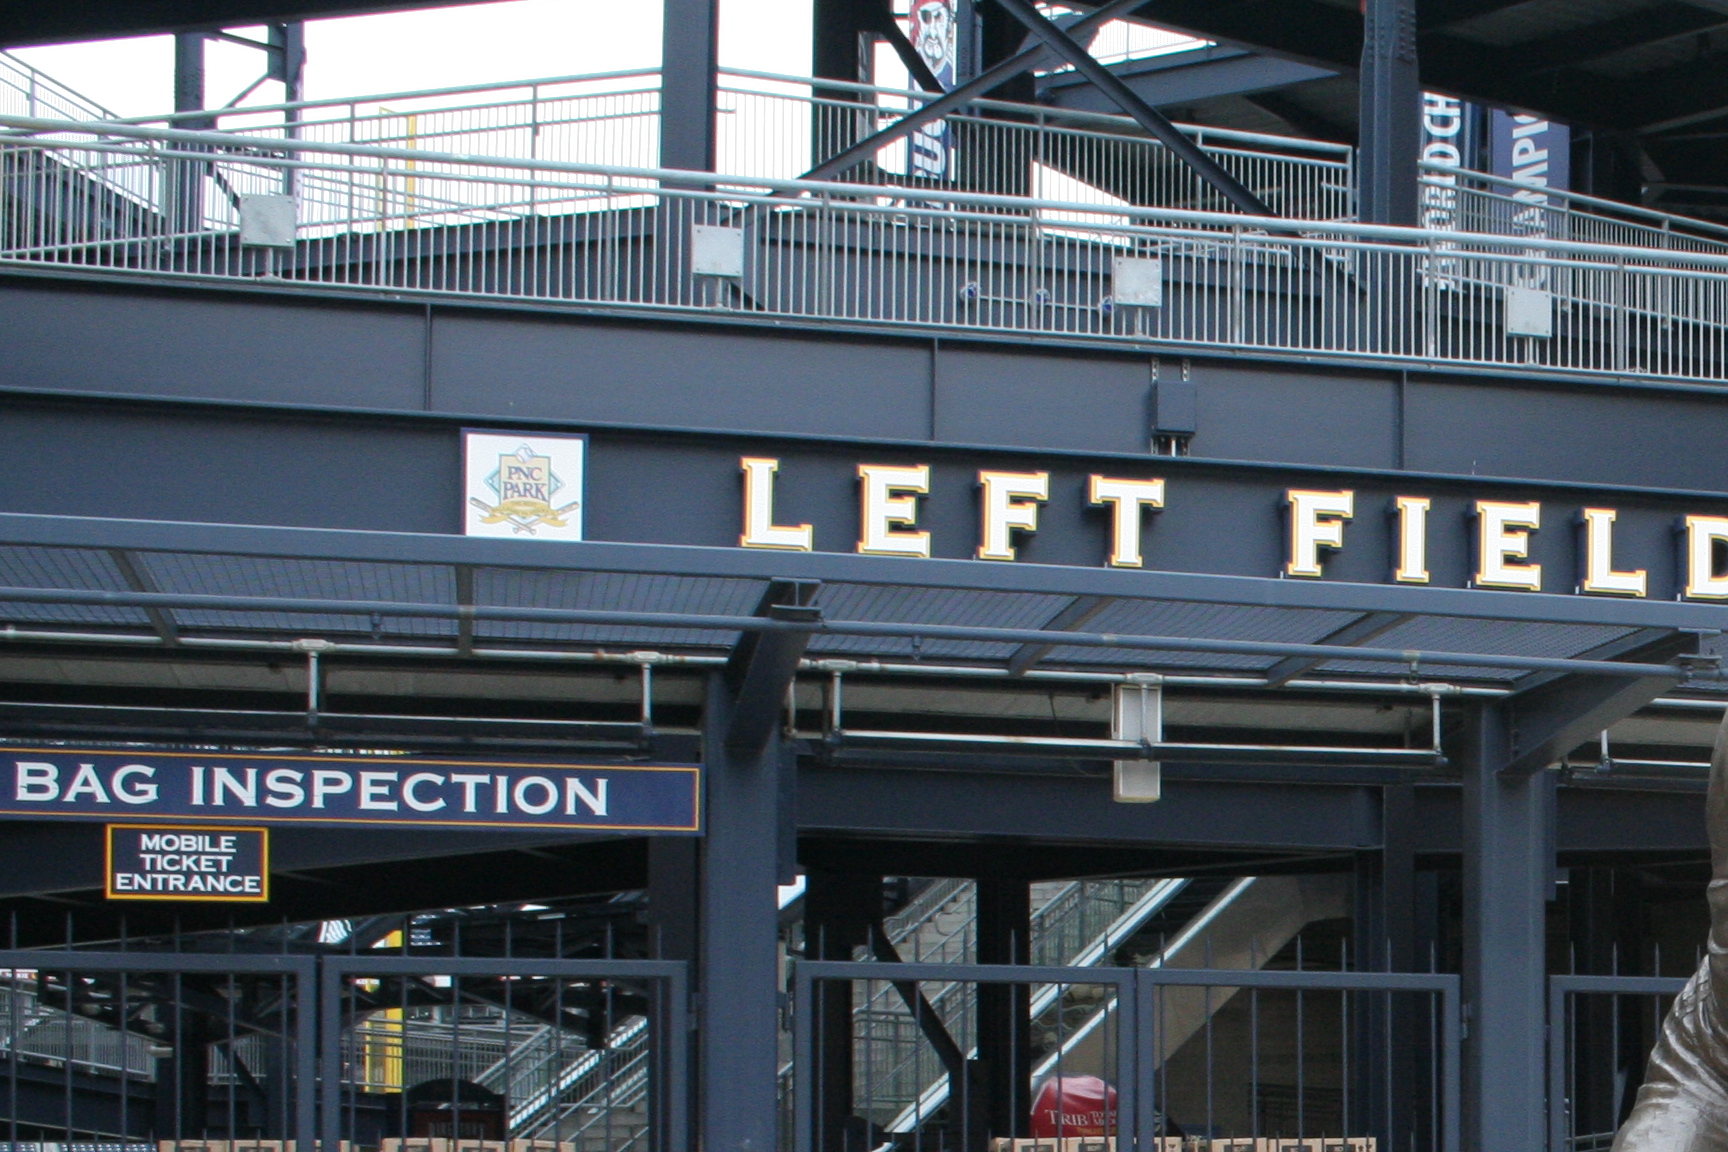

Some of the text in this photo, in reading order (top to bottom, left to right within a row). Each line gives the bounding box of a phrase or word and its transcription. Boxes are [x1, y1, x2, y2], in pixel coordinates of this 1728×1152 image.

[507, 466, 542, 481] PNC
[502, 481, 548, 501] PARK
[740, 456, 1165, 567] LEFT
[15, 761, 609, 816] BAG INSPECTION
[140, 833, 237, 853] MOBILE
[139, 854, 233, 872] TICKET
[116, 873, 261, 893] ENTRANCE
